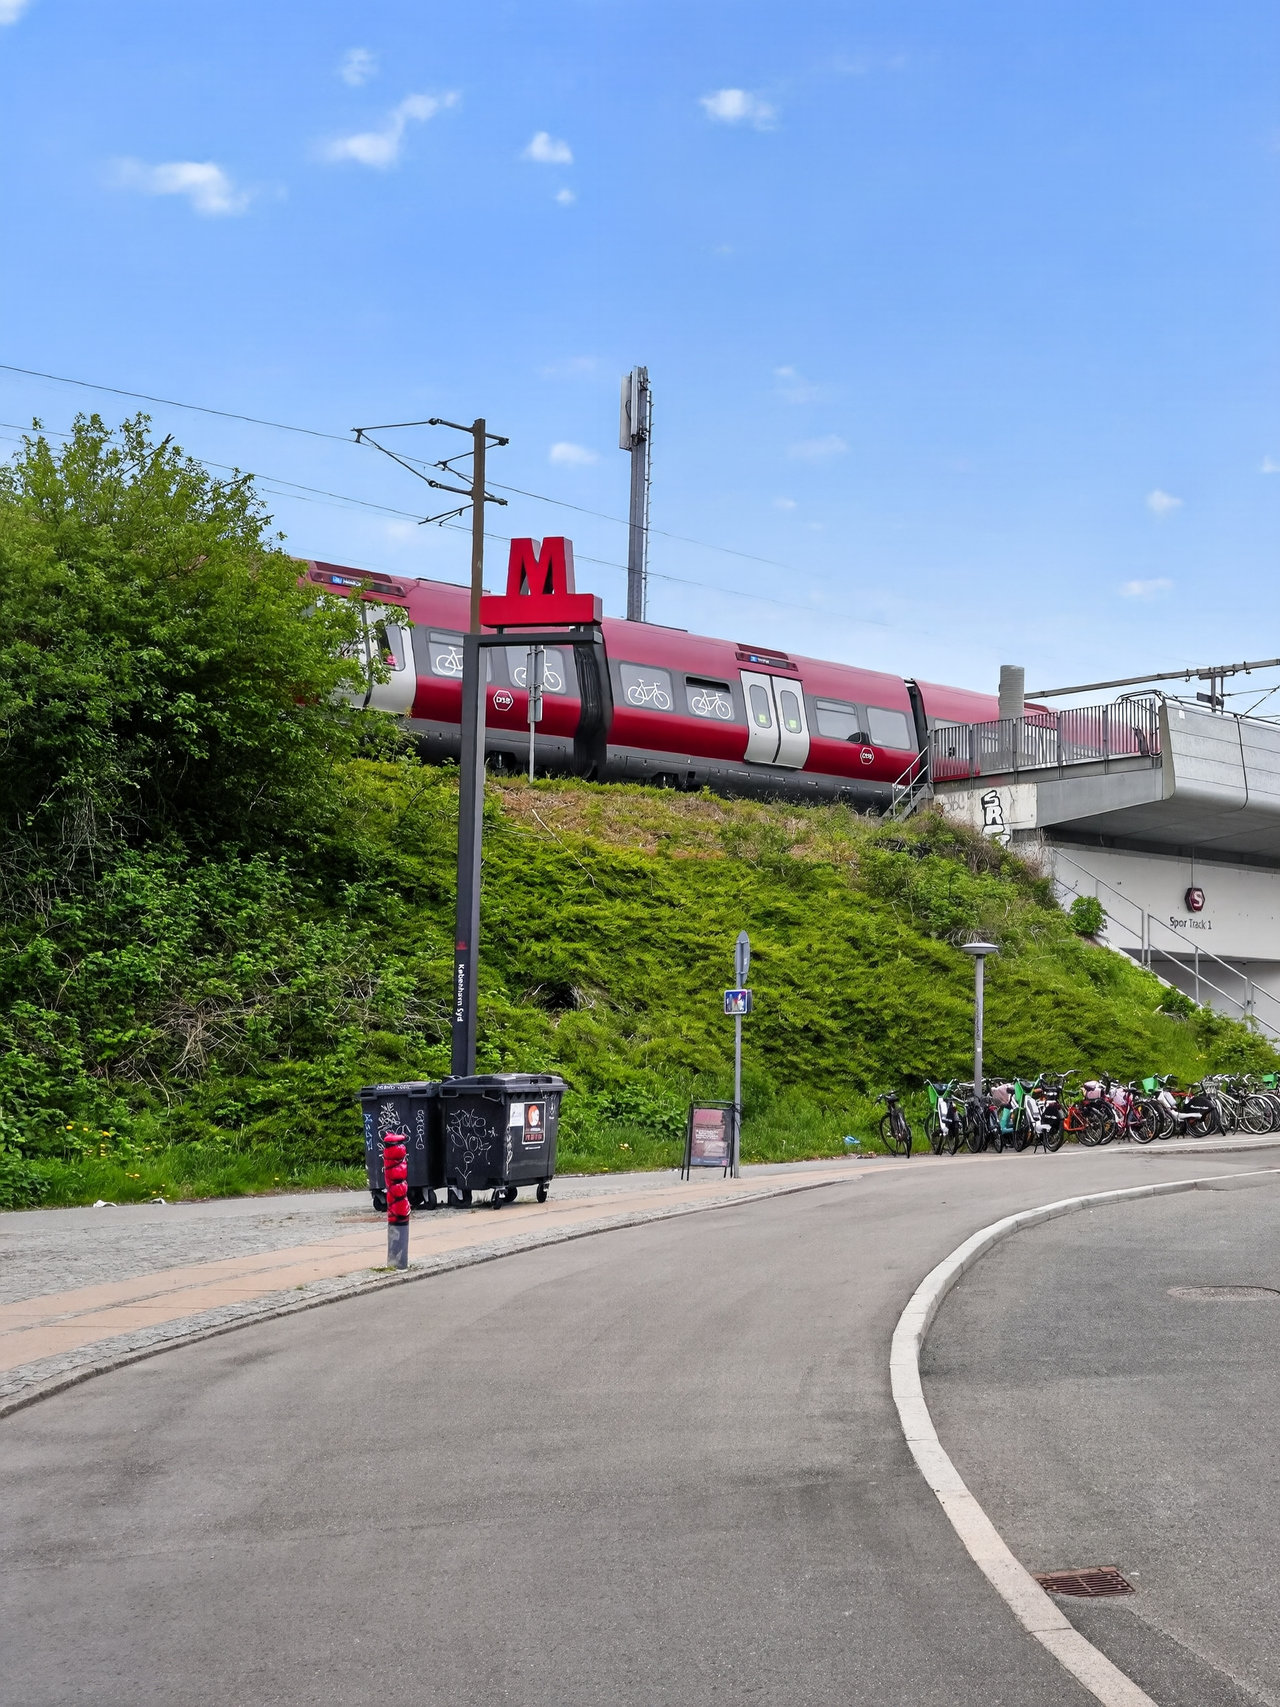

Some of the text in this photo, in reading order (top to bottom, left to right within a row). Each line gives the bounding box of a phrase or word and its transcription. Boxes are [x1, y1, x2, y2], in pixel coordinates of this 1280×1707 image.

[1193, 890, 1203, 907] S
[1169, 916, 1213, 930] Spor Track 1
[455, 963, 465, 1022] København Syd
